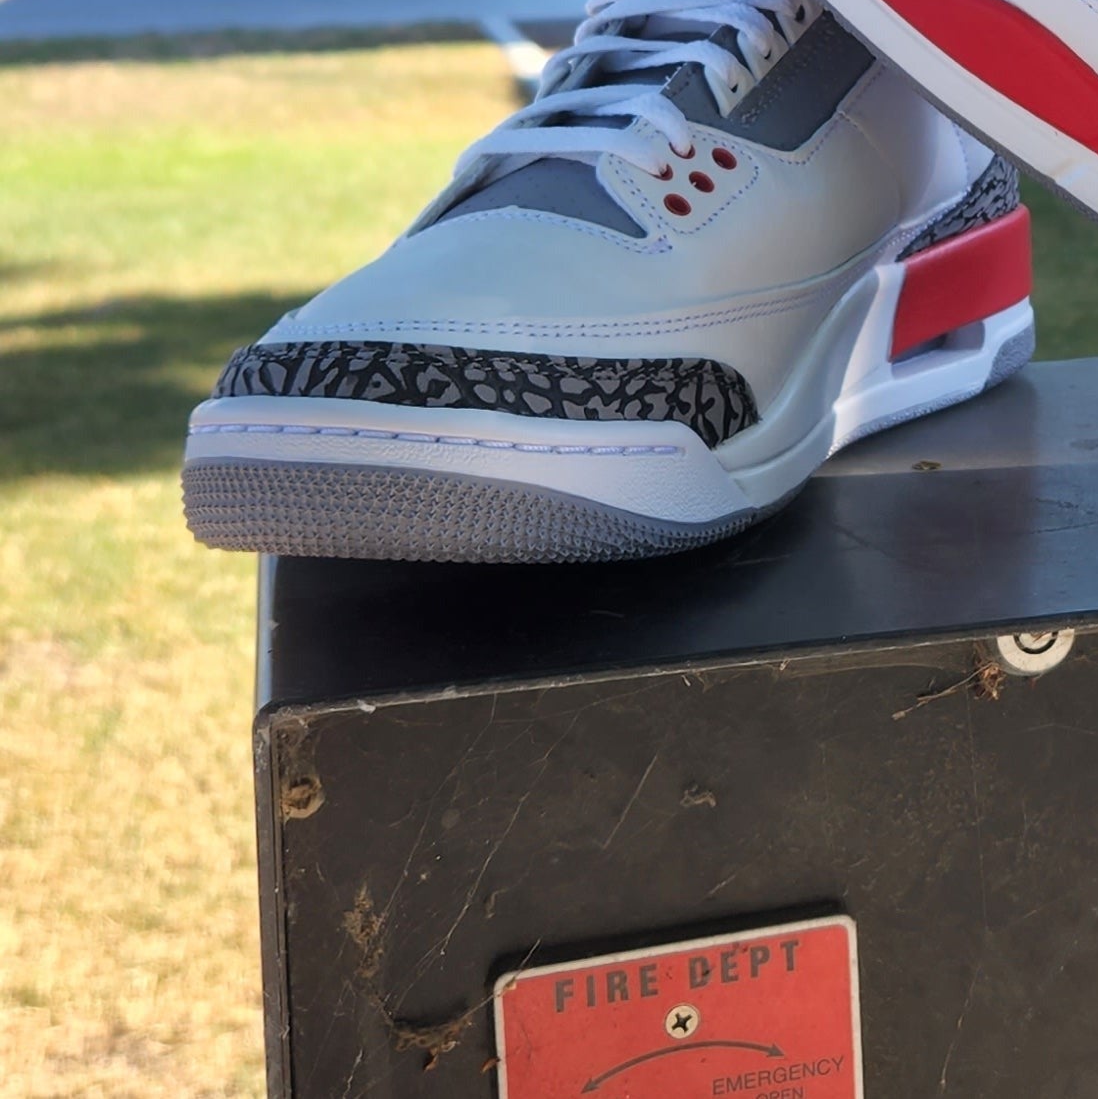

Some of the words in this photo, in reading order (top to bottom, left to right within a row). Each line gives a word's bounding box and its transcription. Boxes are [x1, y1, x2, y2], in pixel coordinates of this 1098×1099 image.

[553, 963, 659, 1014] FIRE
[688, 939, 800, 990] DEPT
[712, 1055, 844, 1096] EMERGENCY
